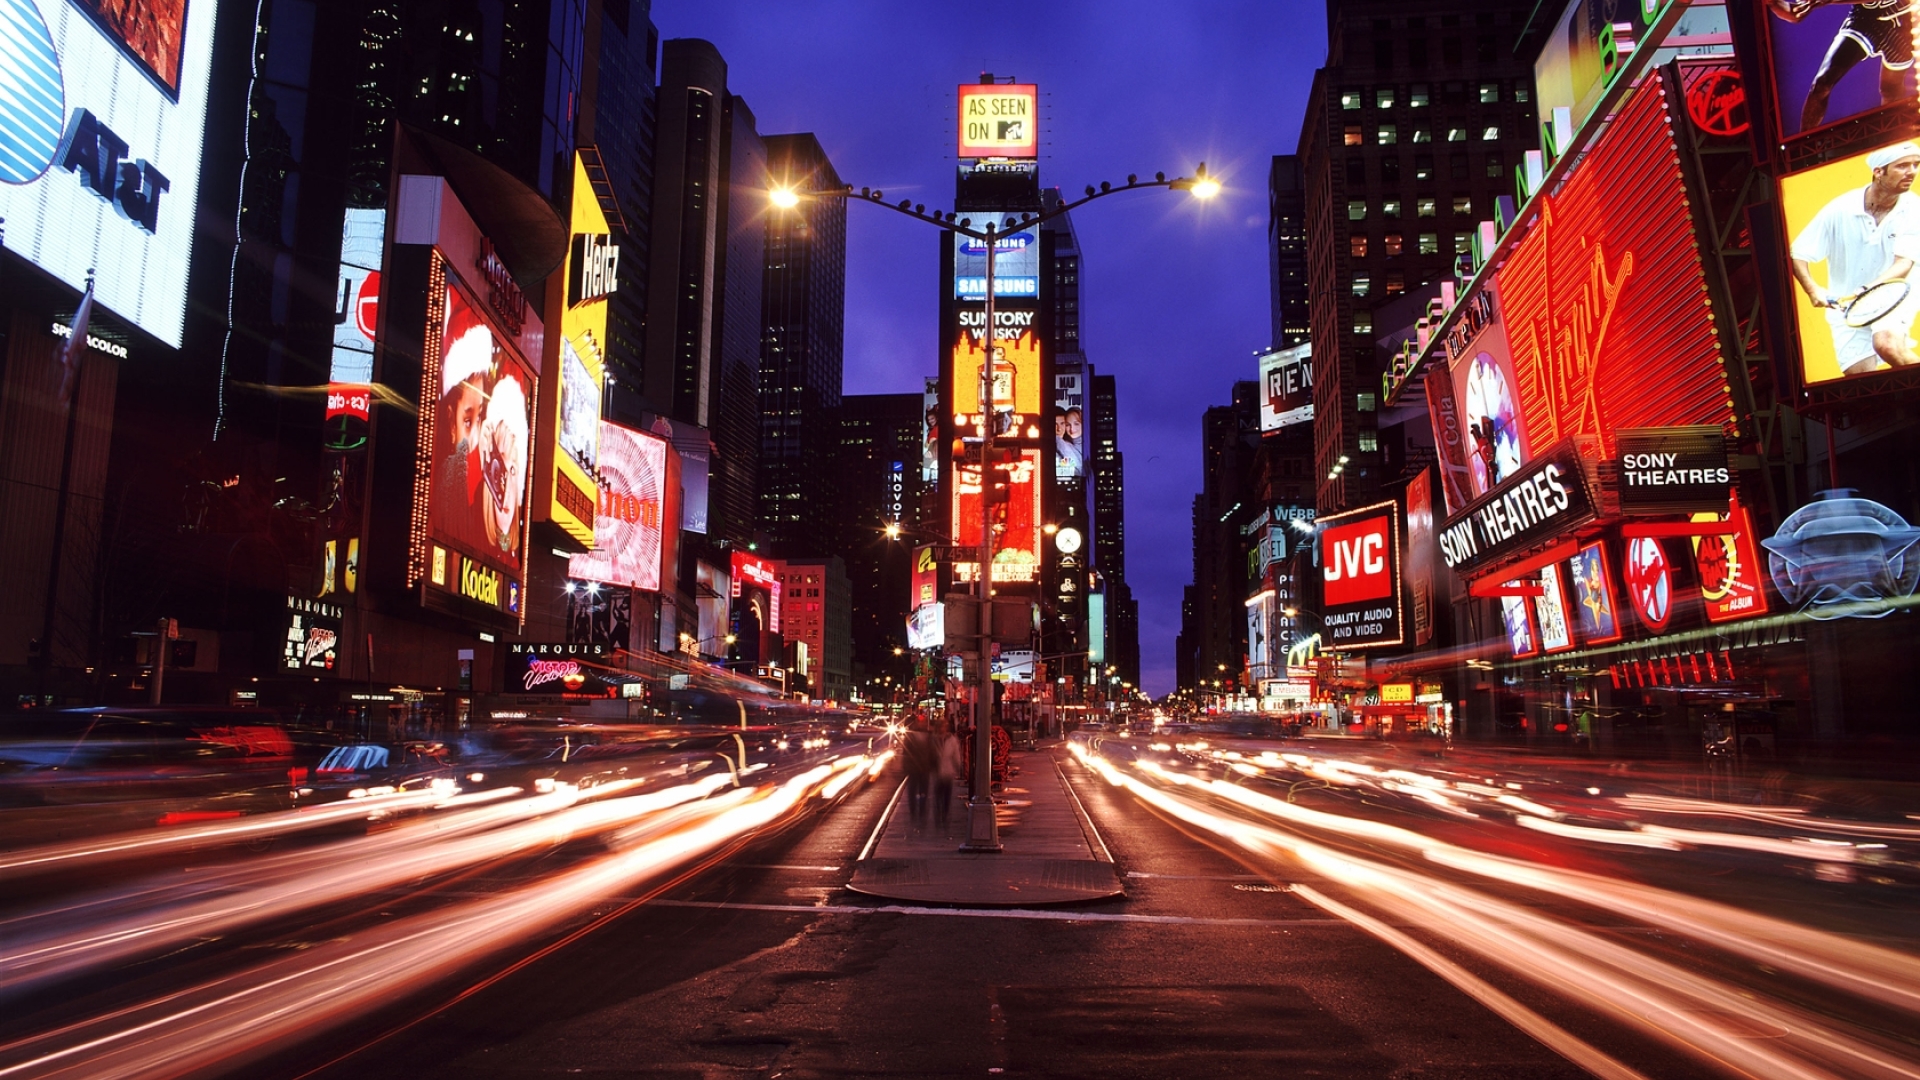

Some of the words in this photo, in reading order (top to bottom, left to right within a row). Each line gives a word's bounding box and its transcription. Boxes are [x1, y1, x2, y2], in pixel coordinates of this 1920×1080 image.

[968, 98, 986, 116] AS
[991, 98, 1026, 116] SEEN
[968, 122, 989, 140] ON
[997, 120, 1027, 140] MTV
[51, 107, 170, 235] AT&T
[968, 238, 1026, 249] SASUNG
[1382, 107, 1572, 402] BERTELSMANN
[581, 232, 620, 301] Hertz
[971, 327, 1022, 340] WISKY
[1528, 196, 1633, 460] Virgin
[51, 322, 128, 359] SPEACOLOR
[1440, 397, 1460, 446] Cola
[1623, 452, 1678, 469] SONY
[1624, 467, 1730, 486] THEATRES
[892, 473, 903, 541] NOVOTEL
[1439, 517, 1479, 568] SONY
[1472, 463, 1570, 549] THEATRES
[694, 519, 706, 530] Lee
[934, 549, 944, 560] W
[948, 547, 963, 560] 45
[1323, 532, 1384, 582] JVC
[1700, 536, 1726, 562] ALL
[461, 556, 499, 607] Kodak
[286, 595, 342, 619] MARQUIS
[1279, 574, 1290, 654] PALACE
[1729, 596, 1753, 612] ALBUM
[1324, 611, 1361, 627] QUALITY
[1363, 607, 1393, 621] AUDIO
[1333, 627, 1352, 639] AND
[1355, 623, 1383, 636] VIDEO
[512, 644, 602, 654] MARQUIS
[529, 660, 579, 674] VICTOR
[1740, 724, 1773, 733] EVITA
